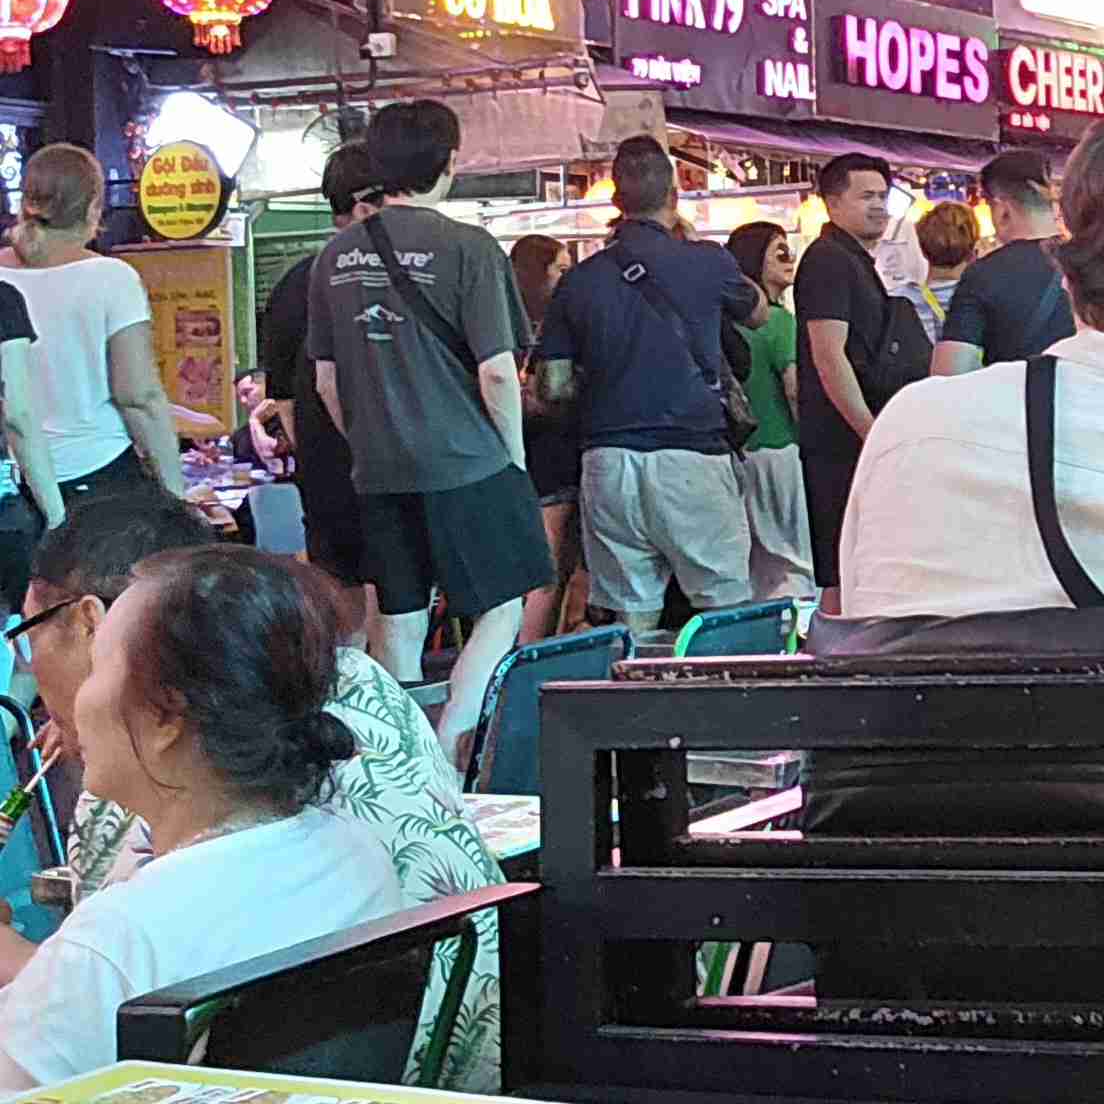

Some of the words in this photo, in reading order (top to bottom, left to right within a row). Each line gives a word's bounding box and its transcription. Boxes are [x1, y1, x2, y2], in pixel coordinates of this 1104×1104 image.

[793, 26, 809, 54] &
[844, 14, 990, 103] HOPES
[764, 59, 817, 100] NAIL
